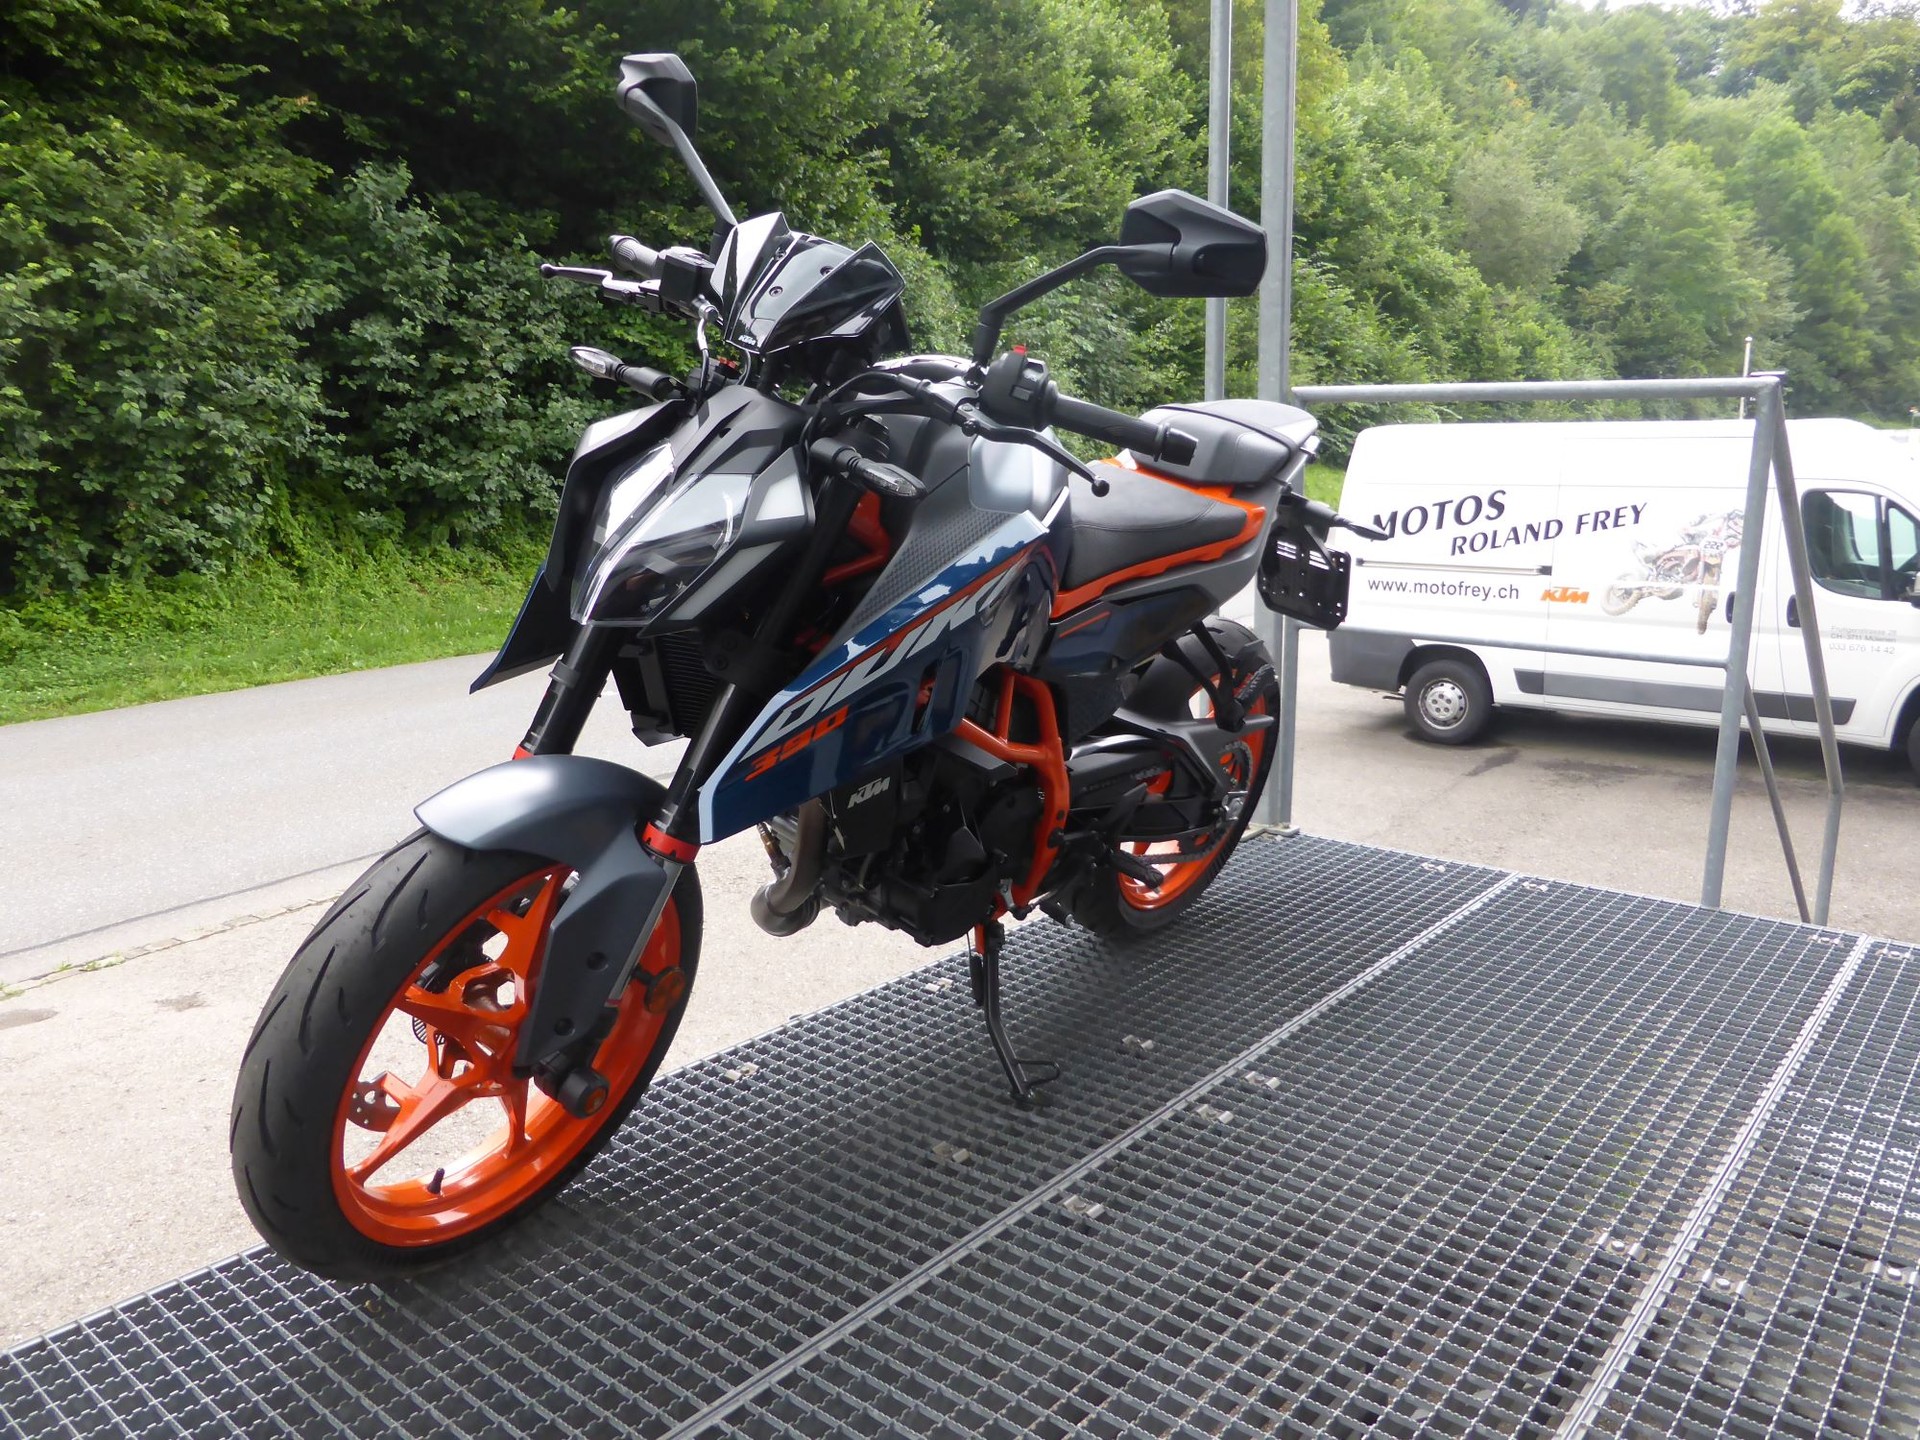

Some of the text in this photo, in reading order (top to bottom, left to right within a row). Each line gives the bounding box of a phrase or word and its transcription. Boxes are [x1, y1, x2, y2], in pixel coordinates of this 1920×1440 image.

[1371, 489, 1507, 541] MOTOS
[1450, 502, 1648, 556] ROLAND FREY
[1367, 579, 1520, 602] www.motofrey.ch
[1540, 586, 1590, 604] KTM
[744, 704, 850, 782] 390
[847, 776, 891, 809] KTM
